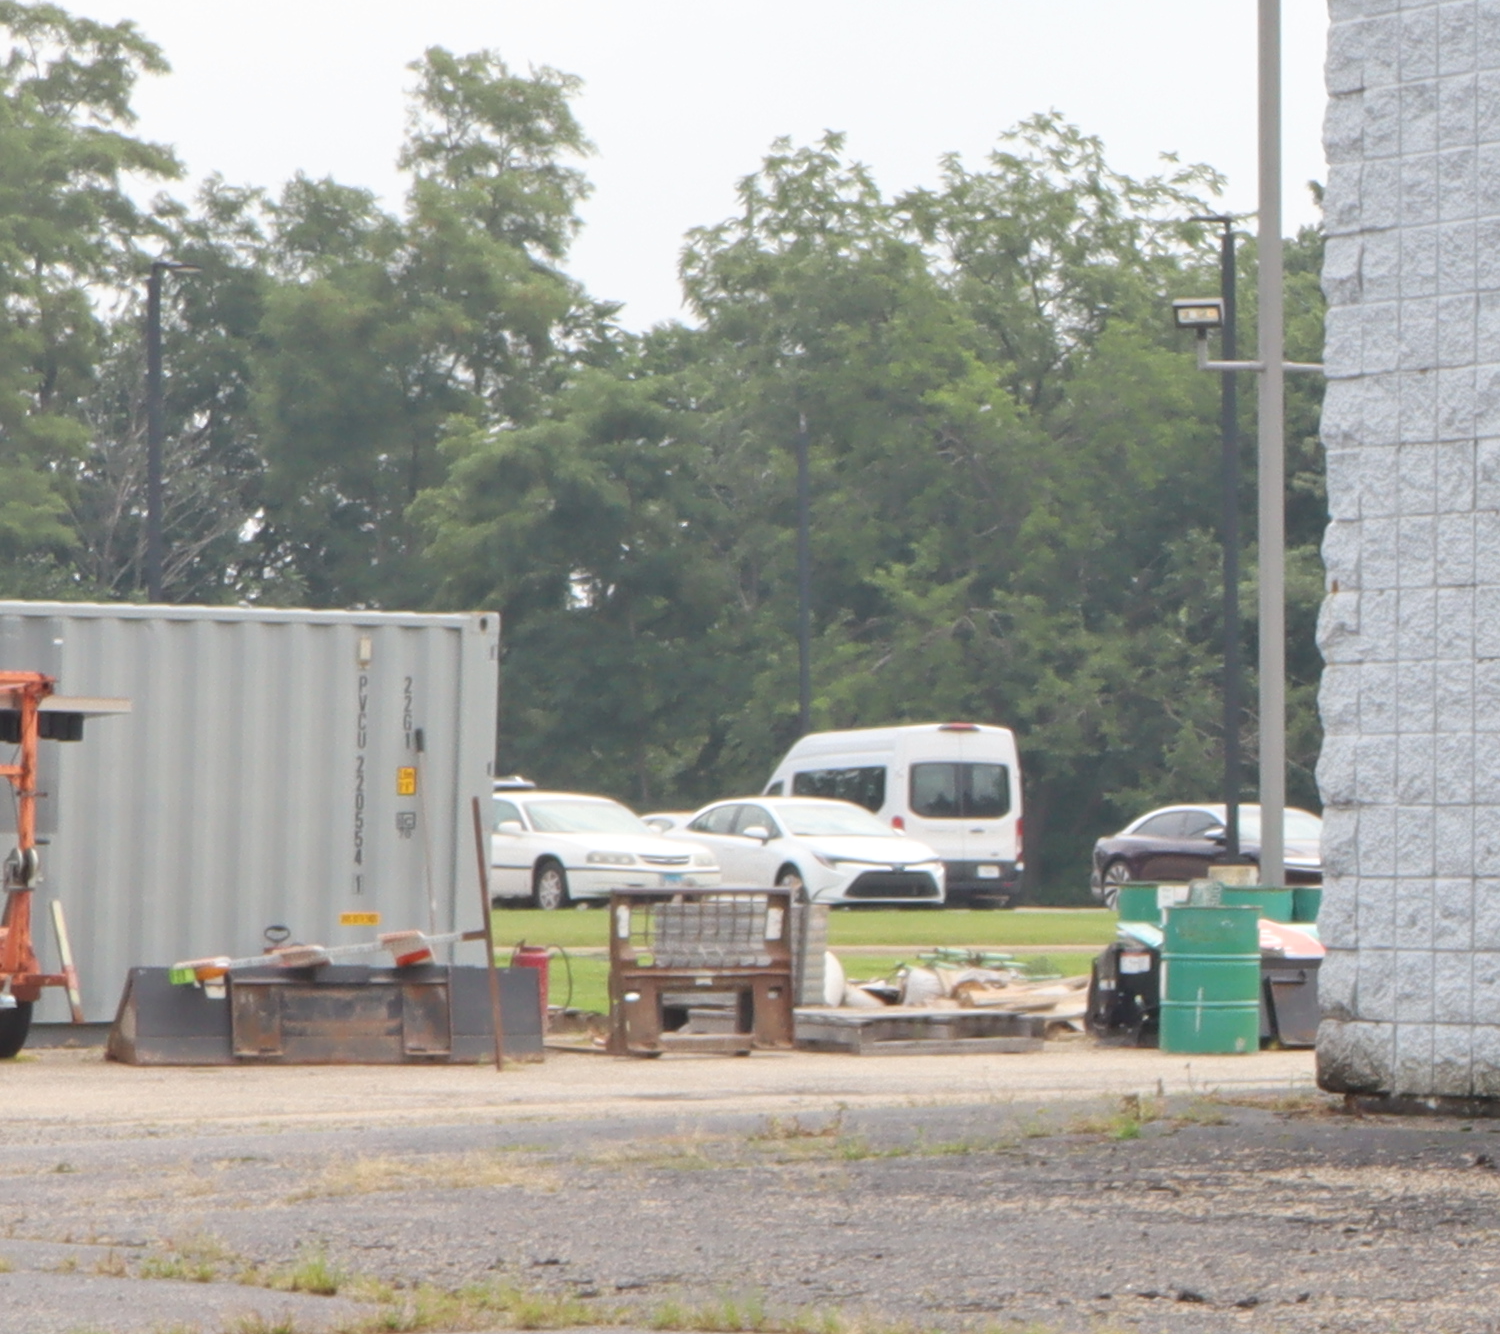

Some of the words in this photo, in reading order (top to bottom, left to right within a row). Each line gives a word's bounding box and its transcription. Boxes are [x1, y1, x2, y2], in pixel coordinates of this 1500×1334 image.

[357, 675, 368, 750] PVCU
[402, 675, 413, 750] 22G1
[353, 755, 365, 867] 220554
